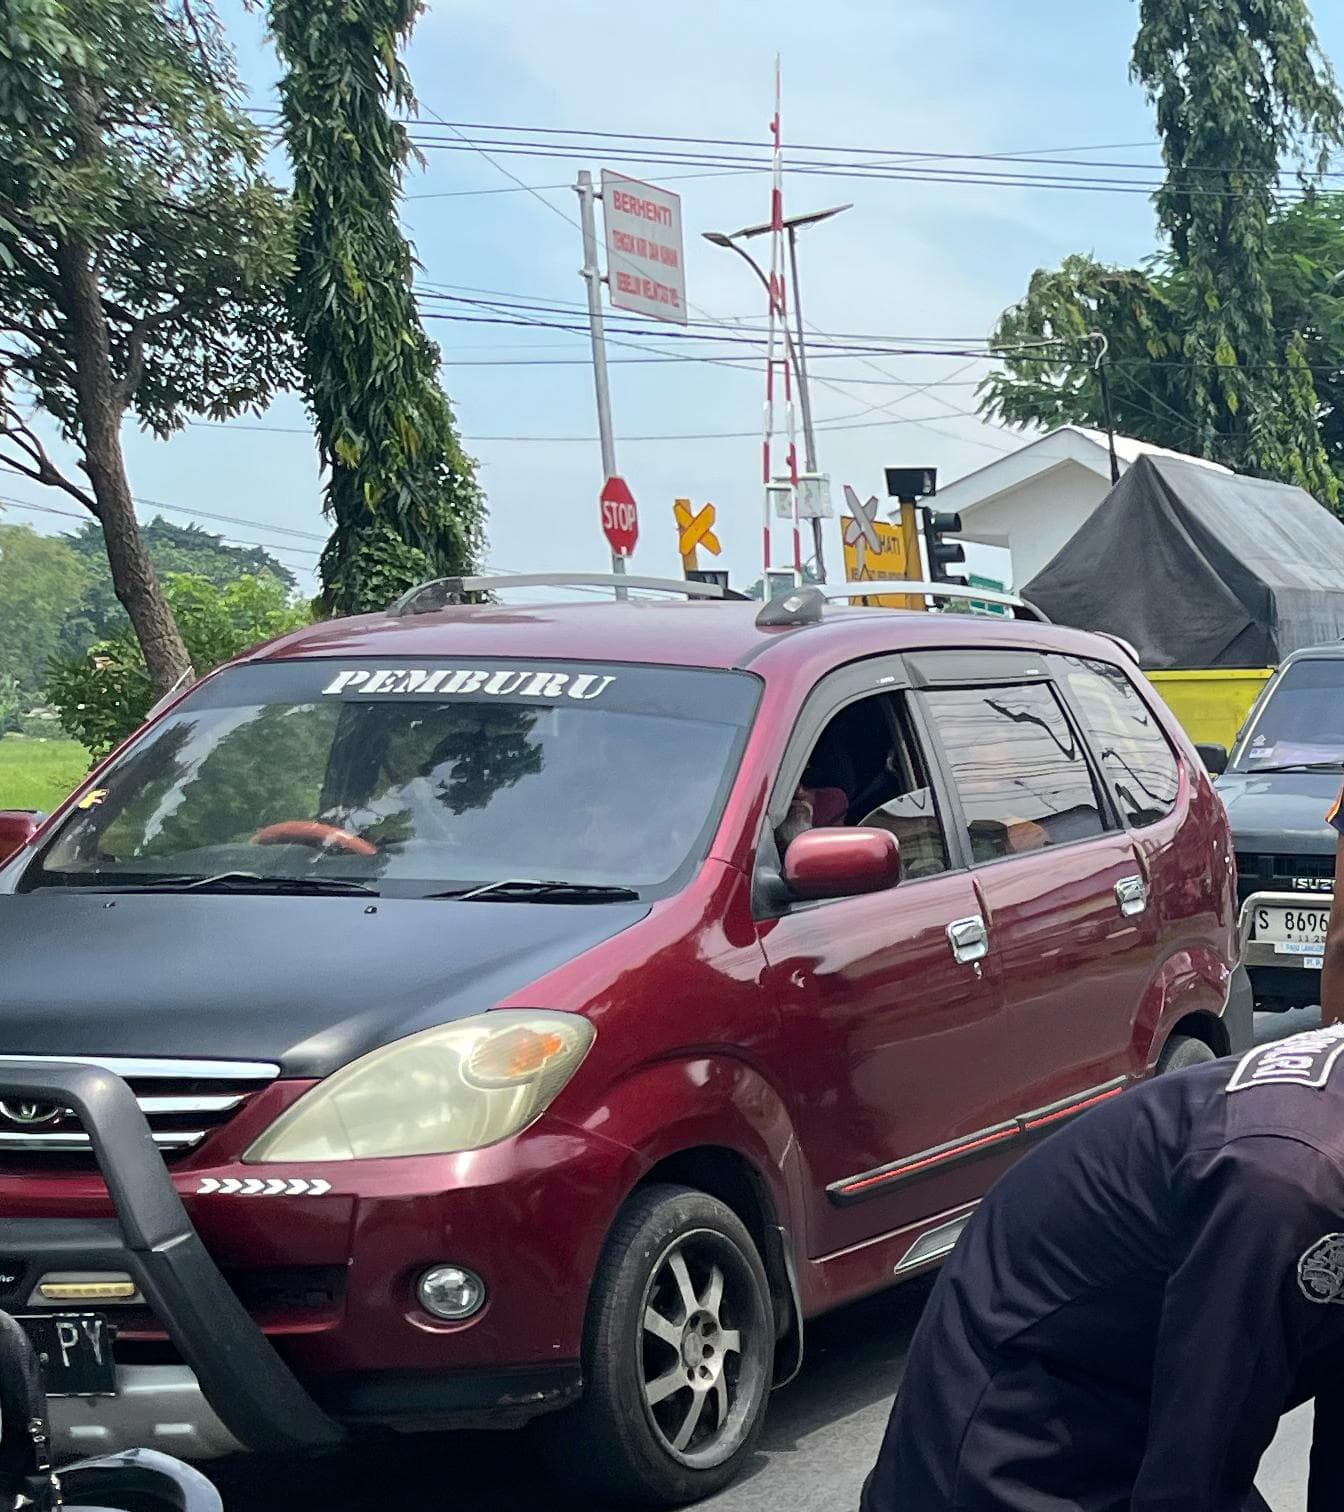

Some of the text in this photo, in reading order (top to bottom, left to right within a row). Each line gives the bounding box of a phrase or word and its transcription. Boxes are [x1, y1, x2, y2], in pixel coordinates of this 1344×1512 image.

[613, 190, 672, 227] BERHENTI
[603, 500, 636, 531] STOP
[321, 670, 616, 700] PEMBURU
[1292, 878, 1335, 890] ISUZ
[1258, 909, 1329, 932] S 8696
[55, 1321, 103, 1368] PY
